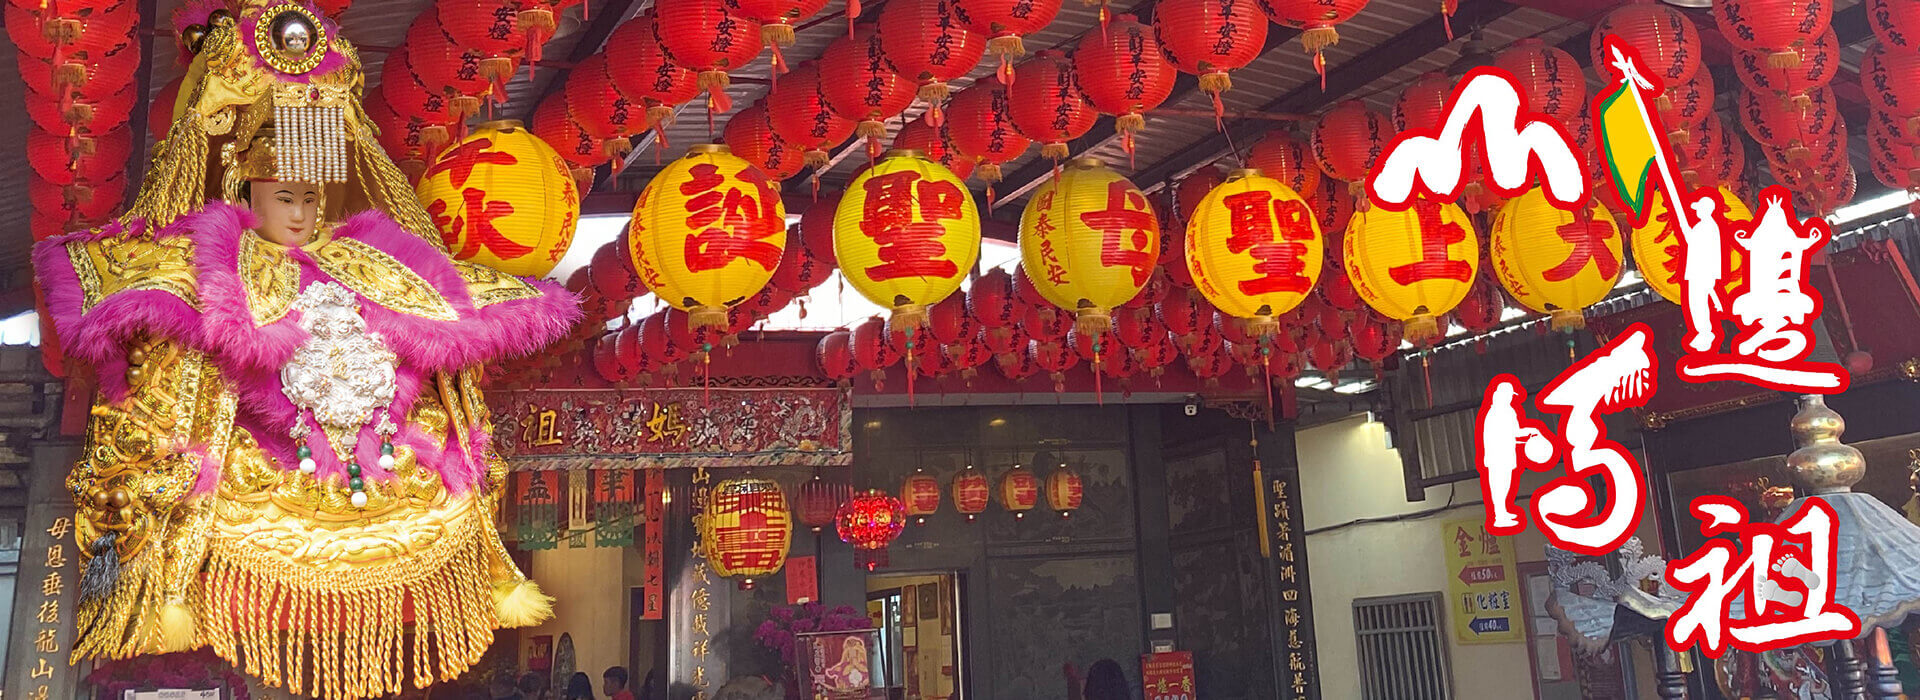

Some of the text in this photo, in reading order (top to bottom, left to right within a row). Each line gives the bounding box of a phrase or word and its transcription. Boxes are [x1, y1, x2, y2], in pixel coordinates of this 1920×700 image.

[680, 163, 785, 273] 誕
[859, 170, 964, 282] 聖
[1034, 190, 1070, 287] 國泰民安
[1080, 179, 1160, 288] 母
[1223, 190, 1315, 296] 聖
[1389, 197, 1473, 286] 上
[521, 402, 688, 448] 媽 祖
[1272, 480, 1308, 700] 聖蹟著湄洲四海慈航普
